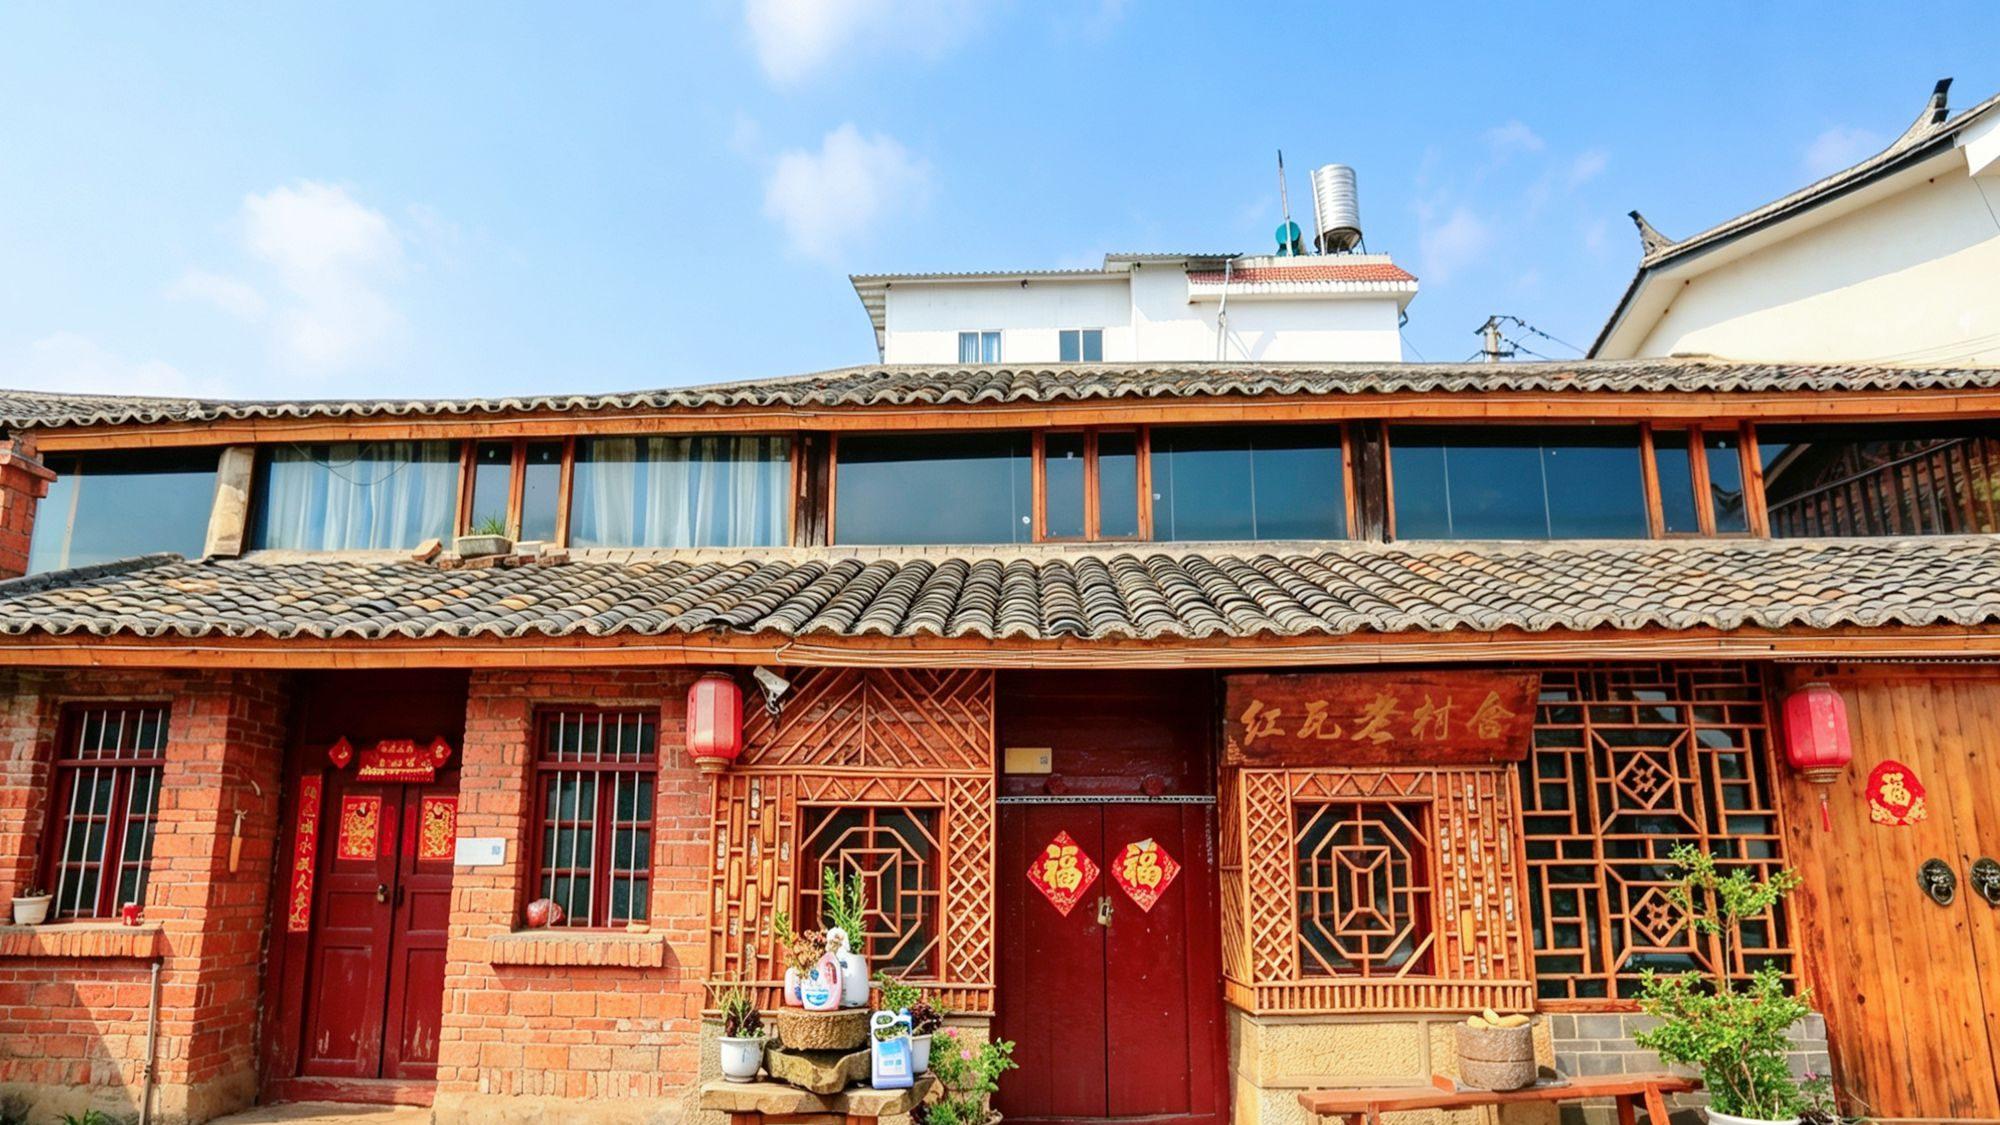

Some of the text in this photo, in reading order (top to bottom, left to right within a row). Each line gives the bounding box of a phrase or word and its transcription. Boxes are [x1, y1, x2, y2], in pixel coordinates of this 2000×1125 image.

[1880, 773, 1911, 807] 福
[1042, 844, 1083, 893] 福
[1123, 840, 1163, 890] 福
